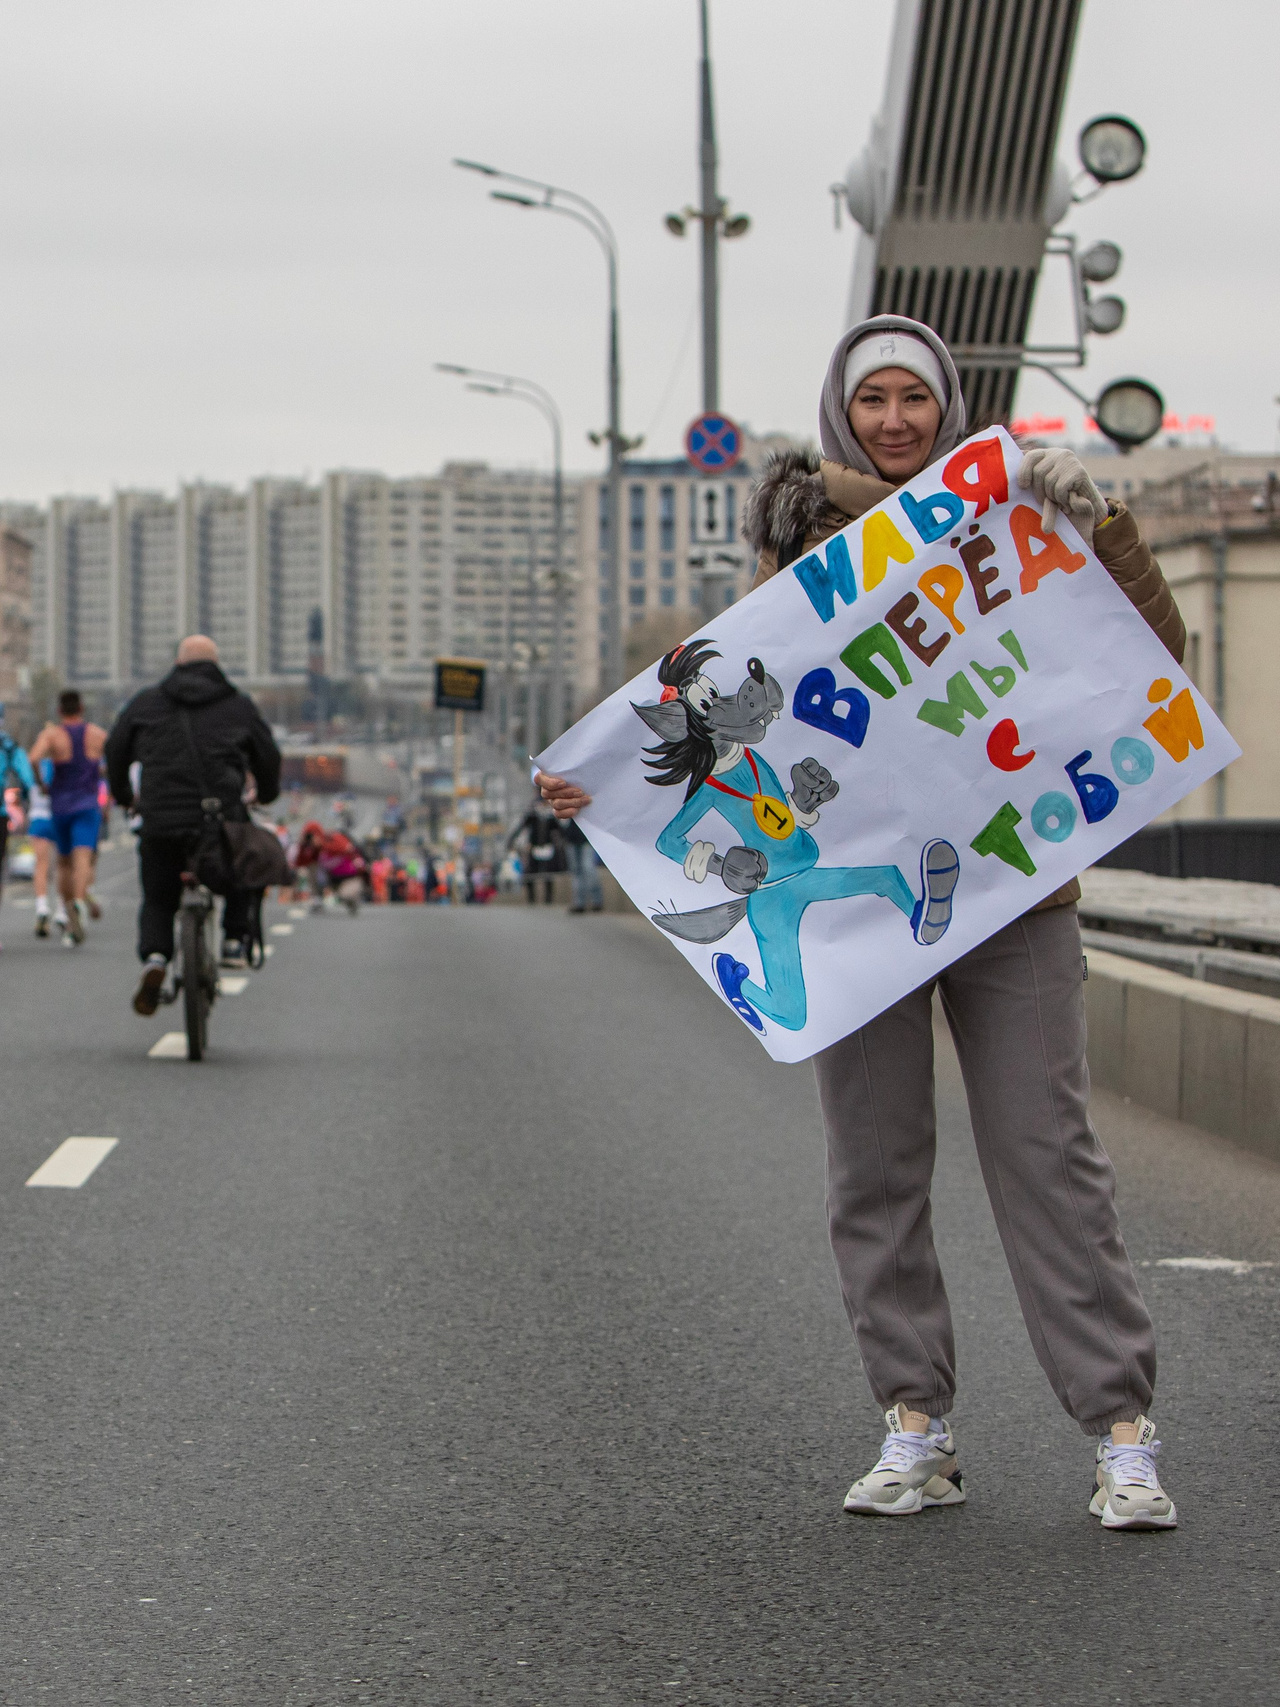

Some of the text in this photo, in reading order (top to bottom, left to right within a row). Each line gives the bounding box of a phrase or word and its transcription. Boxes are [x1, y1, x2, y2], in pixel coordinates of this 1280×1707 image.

[792, 436, 1009, 623] ИЛЬЯ
[792, 504, 1087, 748] ВПЕРЁД
[917, 629, 1030, 737] МЫ
[763, 801, 789, 831] 1
[969, 677, 1205, 877] ТОБОЙ
[986, 718, 1036, 772] С
